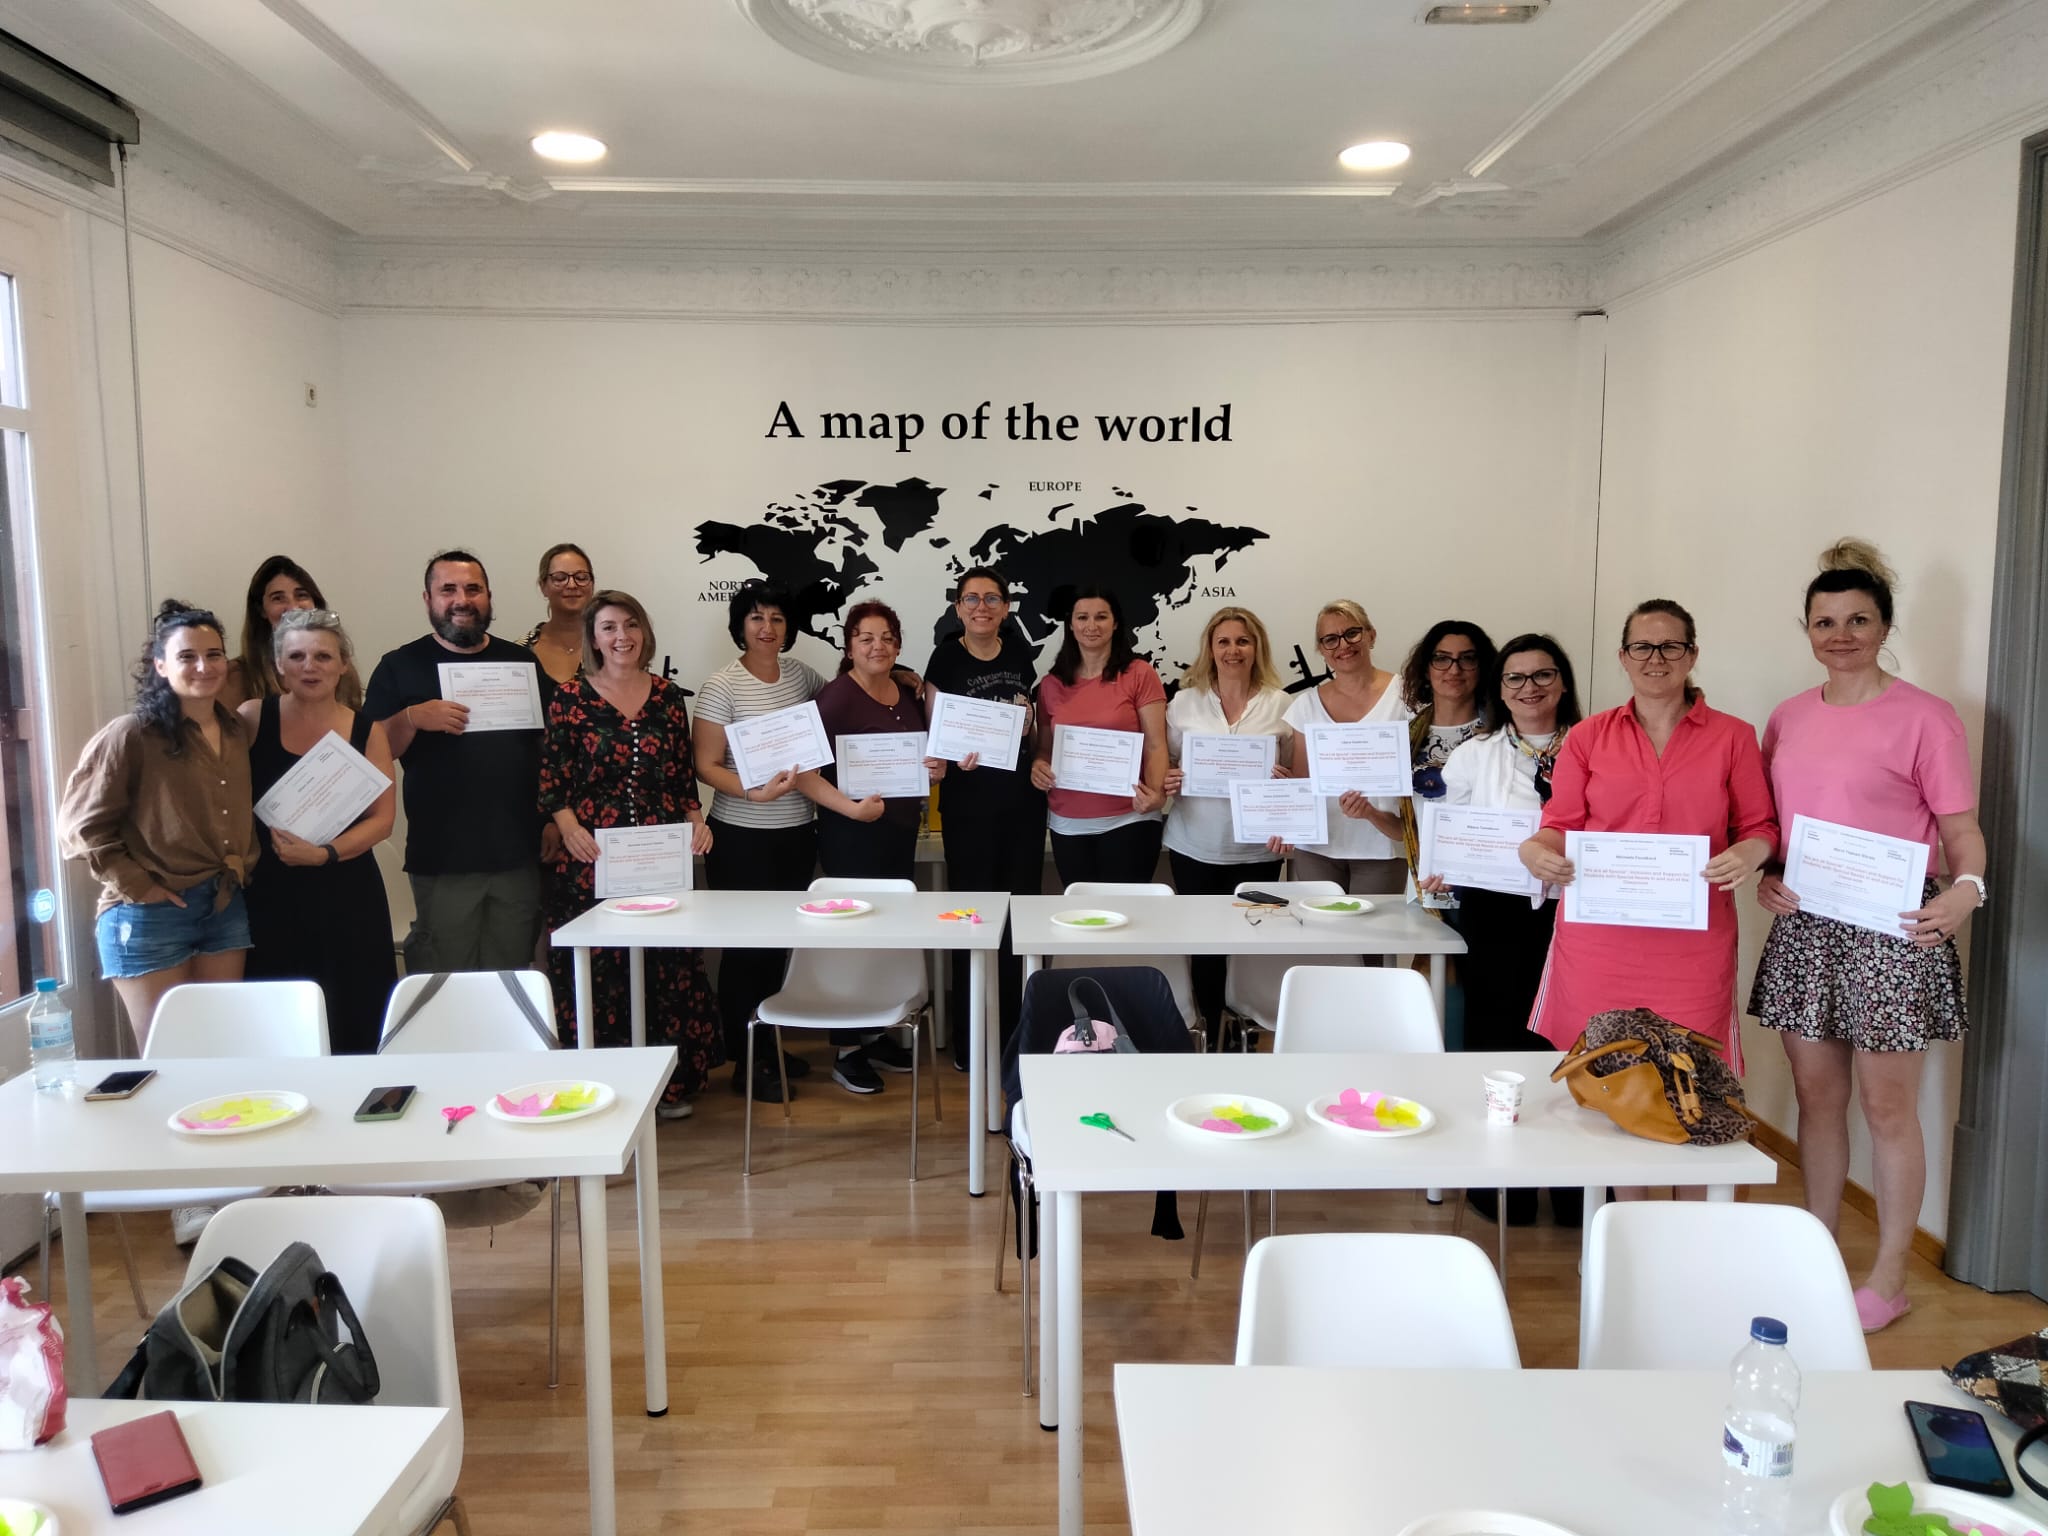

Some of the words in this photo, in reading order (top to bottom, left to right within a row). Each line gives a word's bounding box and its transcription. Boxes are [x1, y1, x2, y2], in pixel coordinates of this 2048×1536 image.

[765, 400, 805, 438] A
[819, 412, 925, 453] map
[941, 400, 991, 440] of
[1005, 401, 1080, 441] the
[1094, 403, 1233, 443] world
[1029, 481, 1082, 492] EUROPE
[709, 580, 747, 591] NORT
[1200, 586, 1237, 598] ASIA
